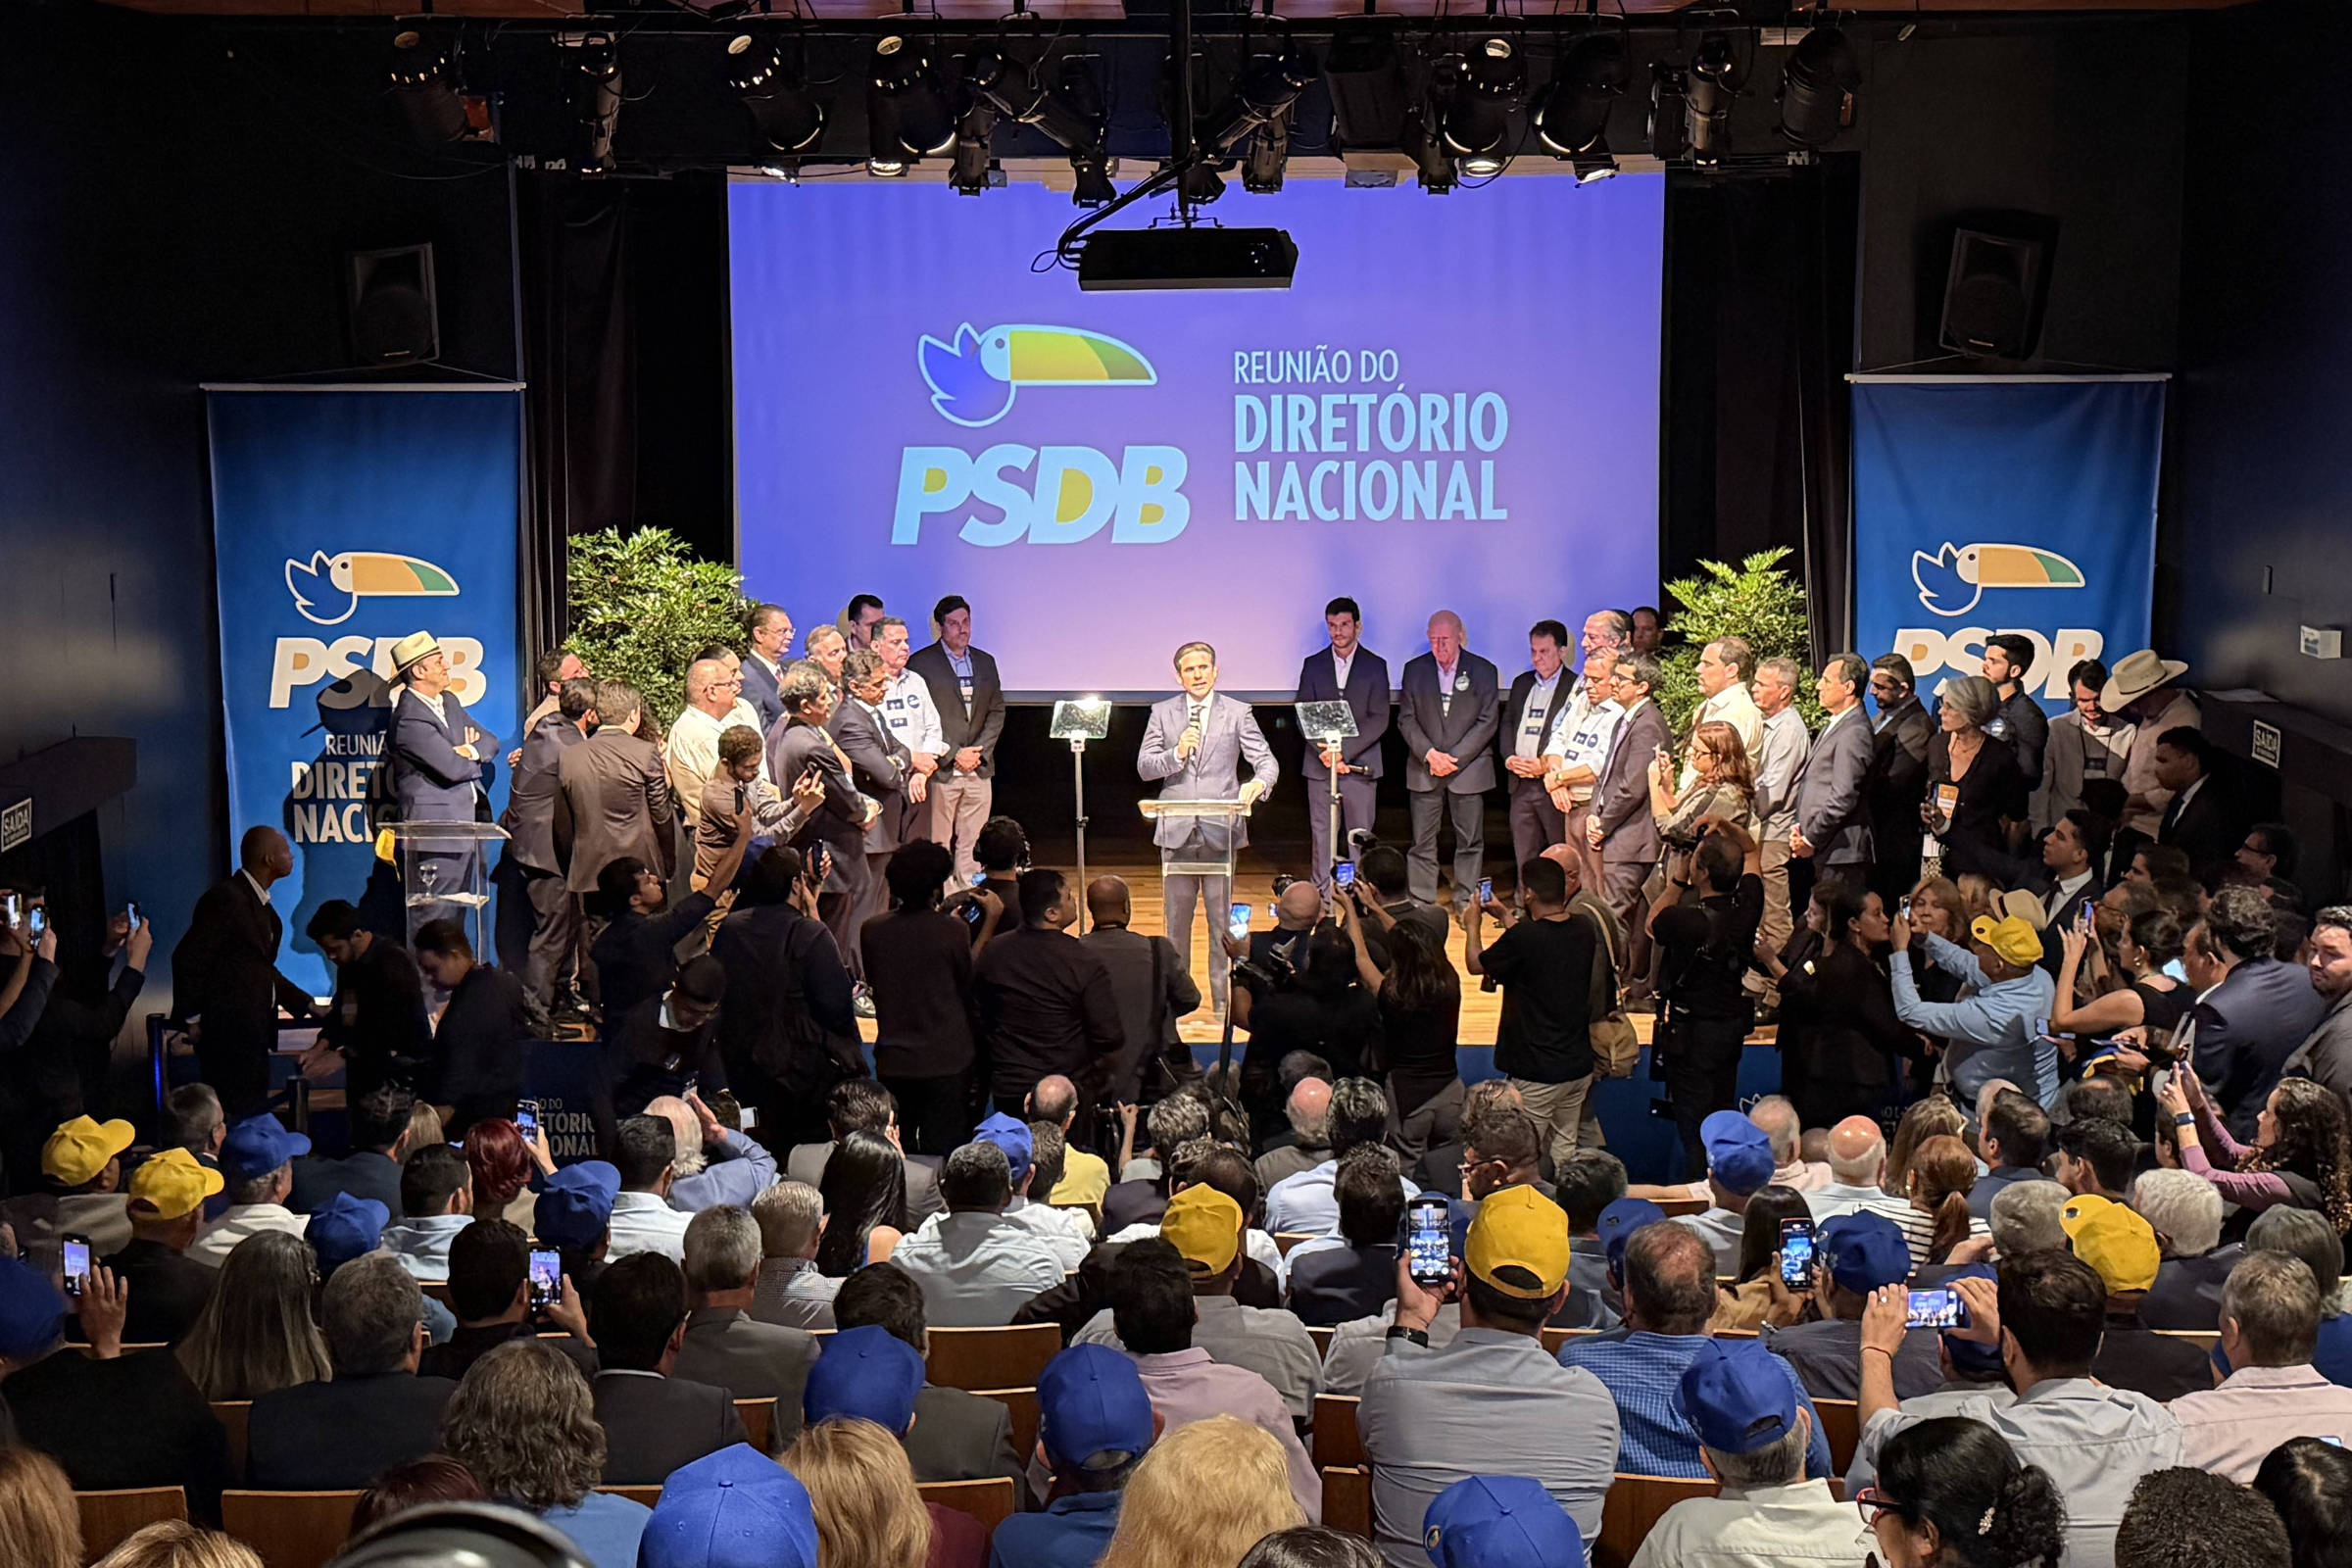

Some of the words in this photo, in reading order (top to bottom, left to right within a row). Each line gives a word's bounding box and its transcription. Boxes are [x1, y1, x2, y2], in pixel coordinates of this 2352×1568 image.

[1234, 345, 1351, 383] REUNIÃO
[1360, 349, 1399, 382] DO
[1234, 383, 1508, 453] DIRETÓRIO
[891, 444, 1191, 547] PSDB
[1235, 460, 1508, 520] NACIONAL
